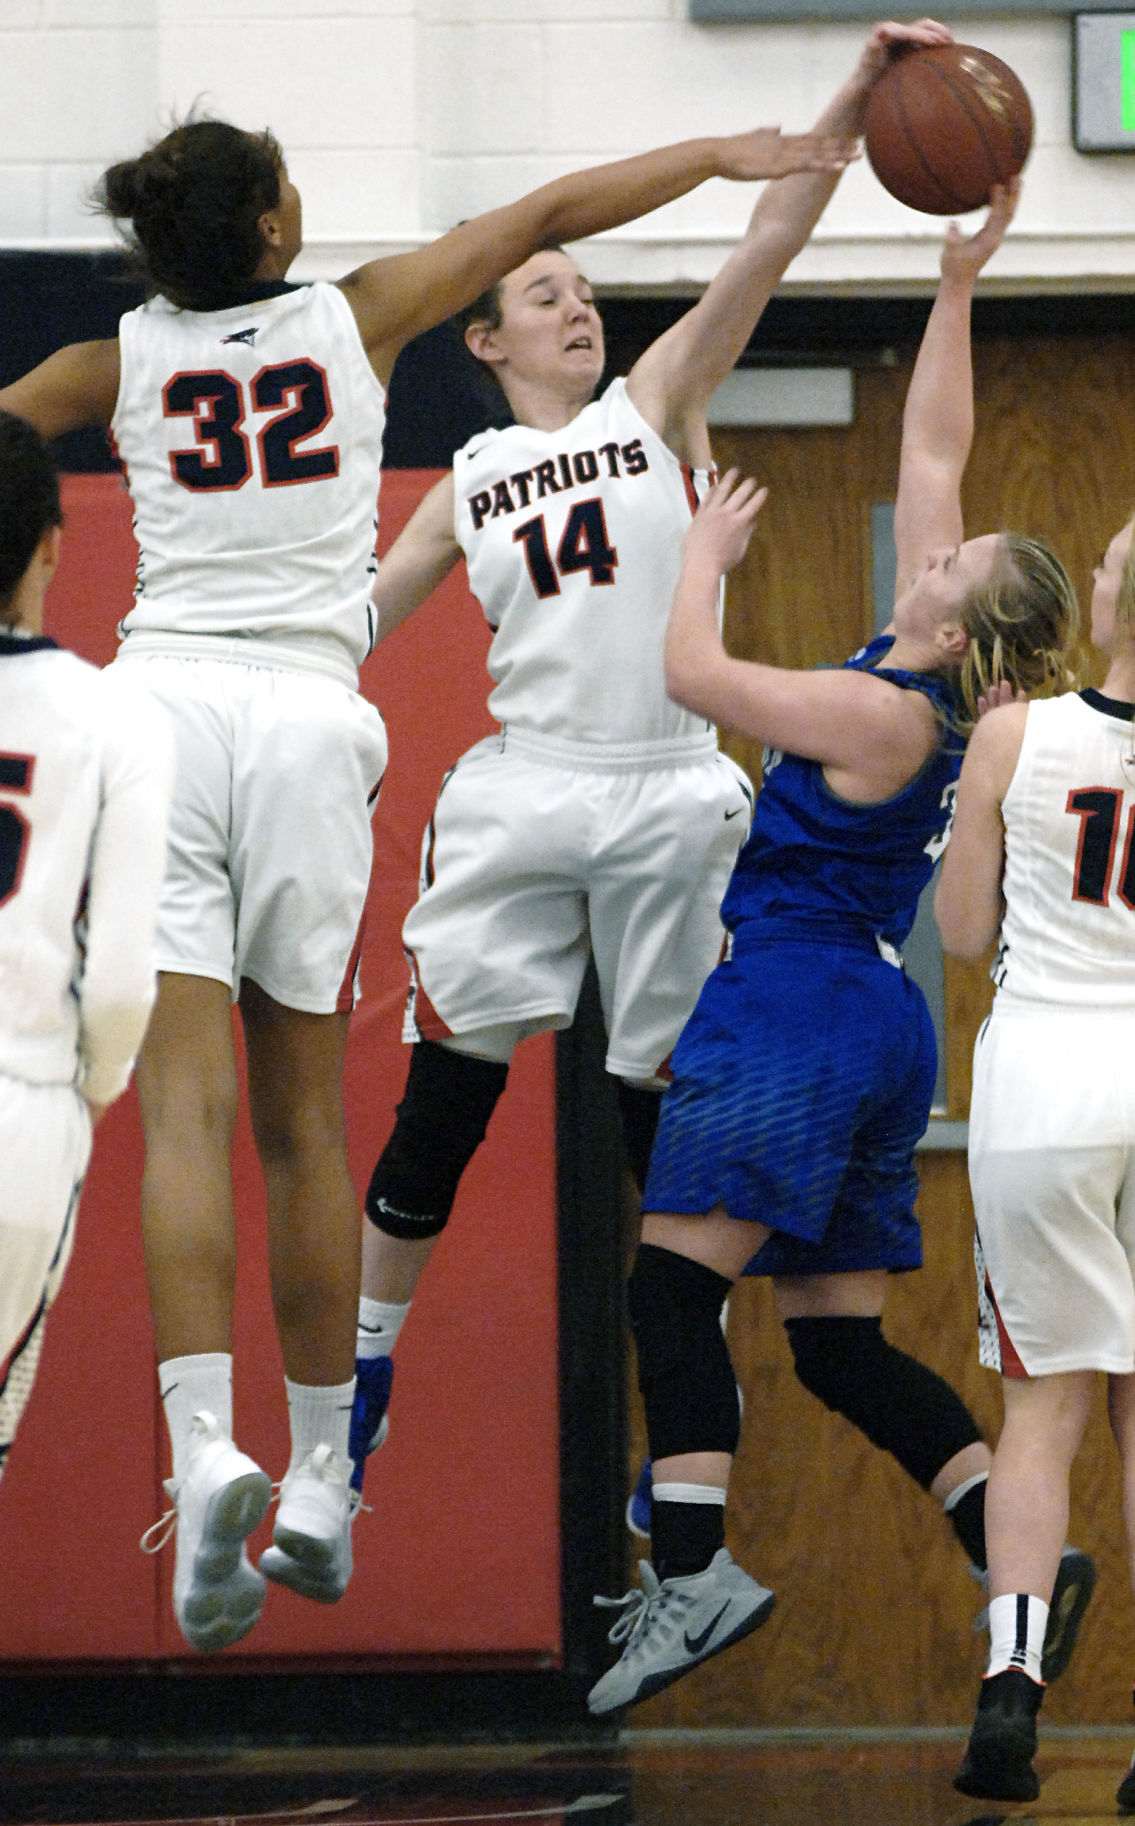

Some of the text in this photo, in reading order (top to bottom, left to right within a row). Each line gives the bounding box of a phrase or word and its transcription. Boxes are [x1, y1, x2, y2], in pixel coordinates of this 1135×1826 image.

[161, 357, 340, 493] 32
[467, 439, 649, 531] PATRIOTS
[513, 497, 619, 600] 14
[1065, 786, 1135, 911] 1
